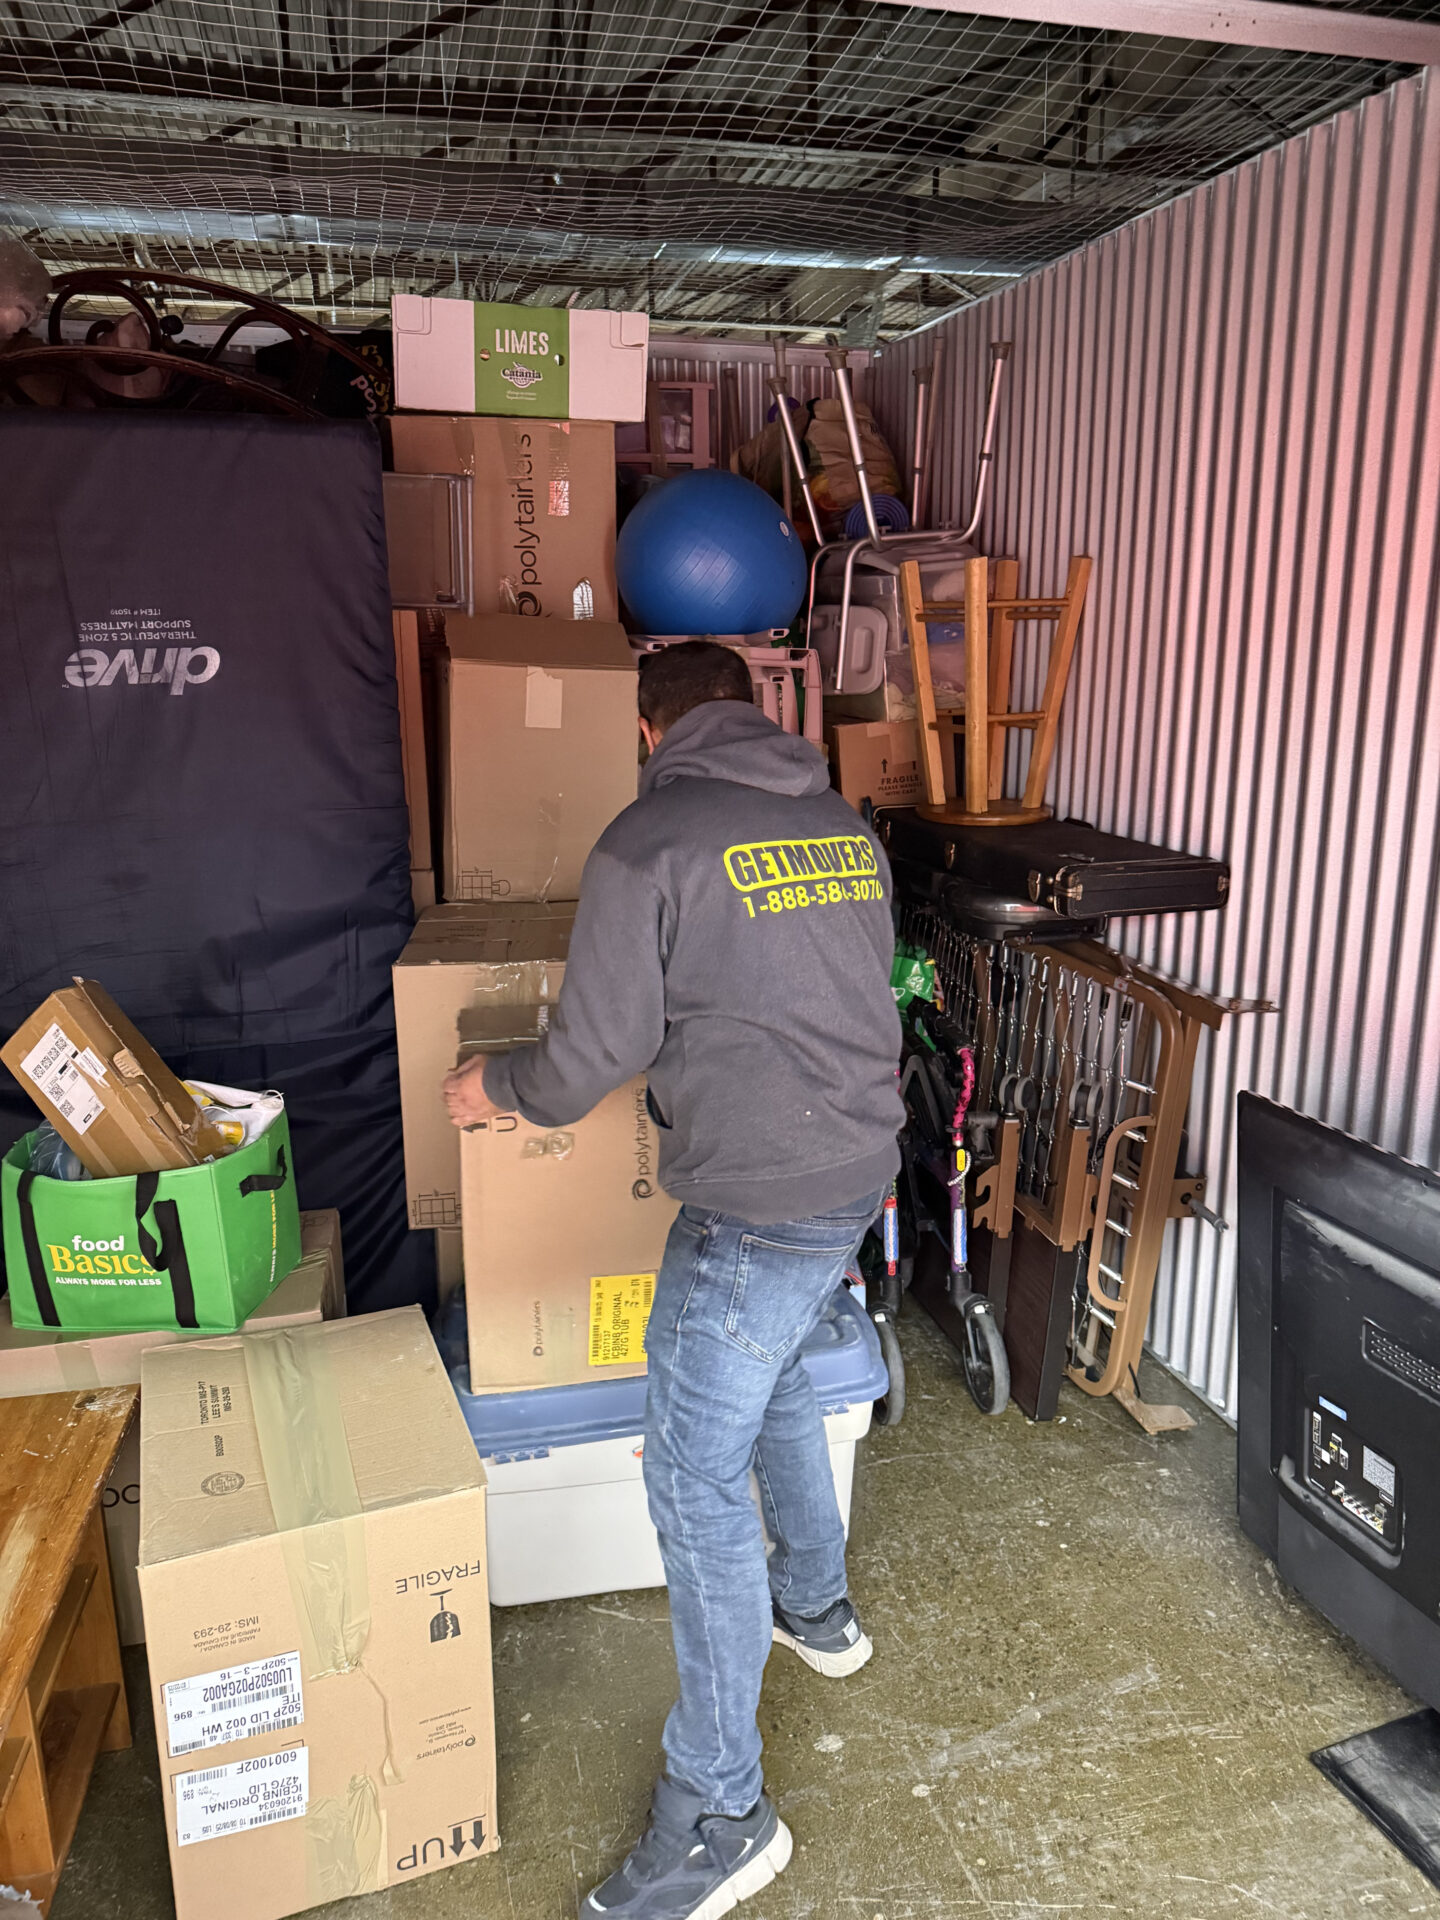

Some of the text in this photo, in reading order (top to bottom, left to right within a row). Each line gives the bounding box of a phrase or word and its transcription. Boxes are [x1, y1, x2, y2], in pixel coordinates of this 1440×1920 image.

[495, 328, 549, 356] LIMES
[502, 368, 541, 379] Catania
[140, 608, 161, 616] ITEM
[80, 619, 191, 631] SUPPORT MATTRESS
[78, 633, 109, 642] ZONE
[111, 632, 118, 641] 5
[64, 646, 221, 695] drive
[881, 774, 919, 785] FRAGILE
[728, 838, 877, 888] GETMOVERS
[632, 1088, 653, 1175] polytainers
[72, 1235, 125, 1252] food
[55, 1276, 89, 1285] ALWAYS
[90, 1278, 117, 1286] MORE
[612, 1291, 622, 1359] ICBINB ORIGINAL
[621, 1319, 629, 1356] 427G TUB
[395, 1560, 480, 1594] FRAGILE
[193, 1616, 259, 1639] IMS: 29-293
[238, 1635, 255, 1643] MADE
[281, 1692, 301, 1705] ITE
[174, 1710, 193, 1721] 896
[202, 1702, 301, 1736] 502P LID 002 WH
[416, 1740, 463, 1760] polytainers
[236, 1751, 296, 1774] 6001002F
[248, 1776, 299, 1795] 427G LID
[263, 1784, 302, 1800] ICBINB
[201, 1794, 259, 1815] ORIGINAL
[258, 1794, 303, 1811] 91206034
[396, 1837, 445, 1871] UP
